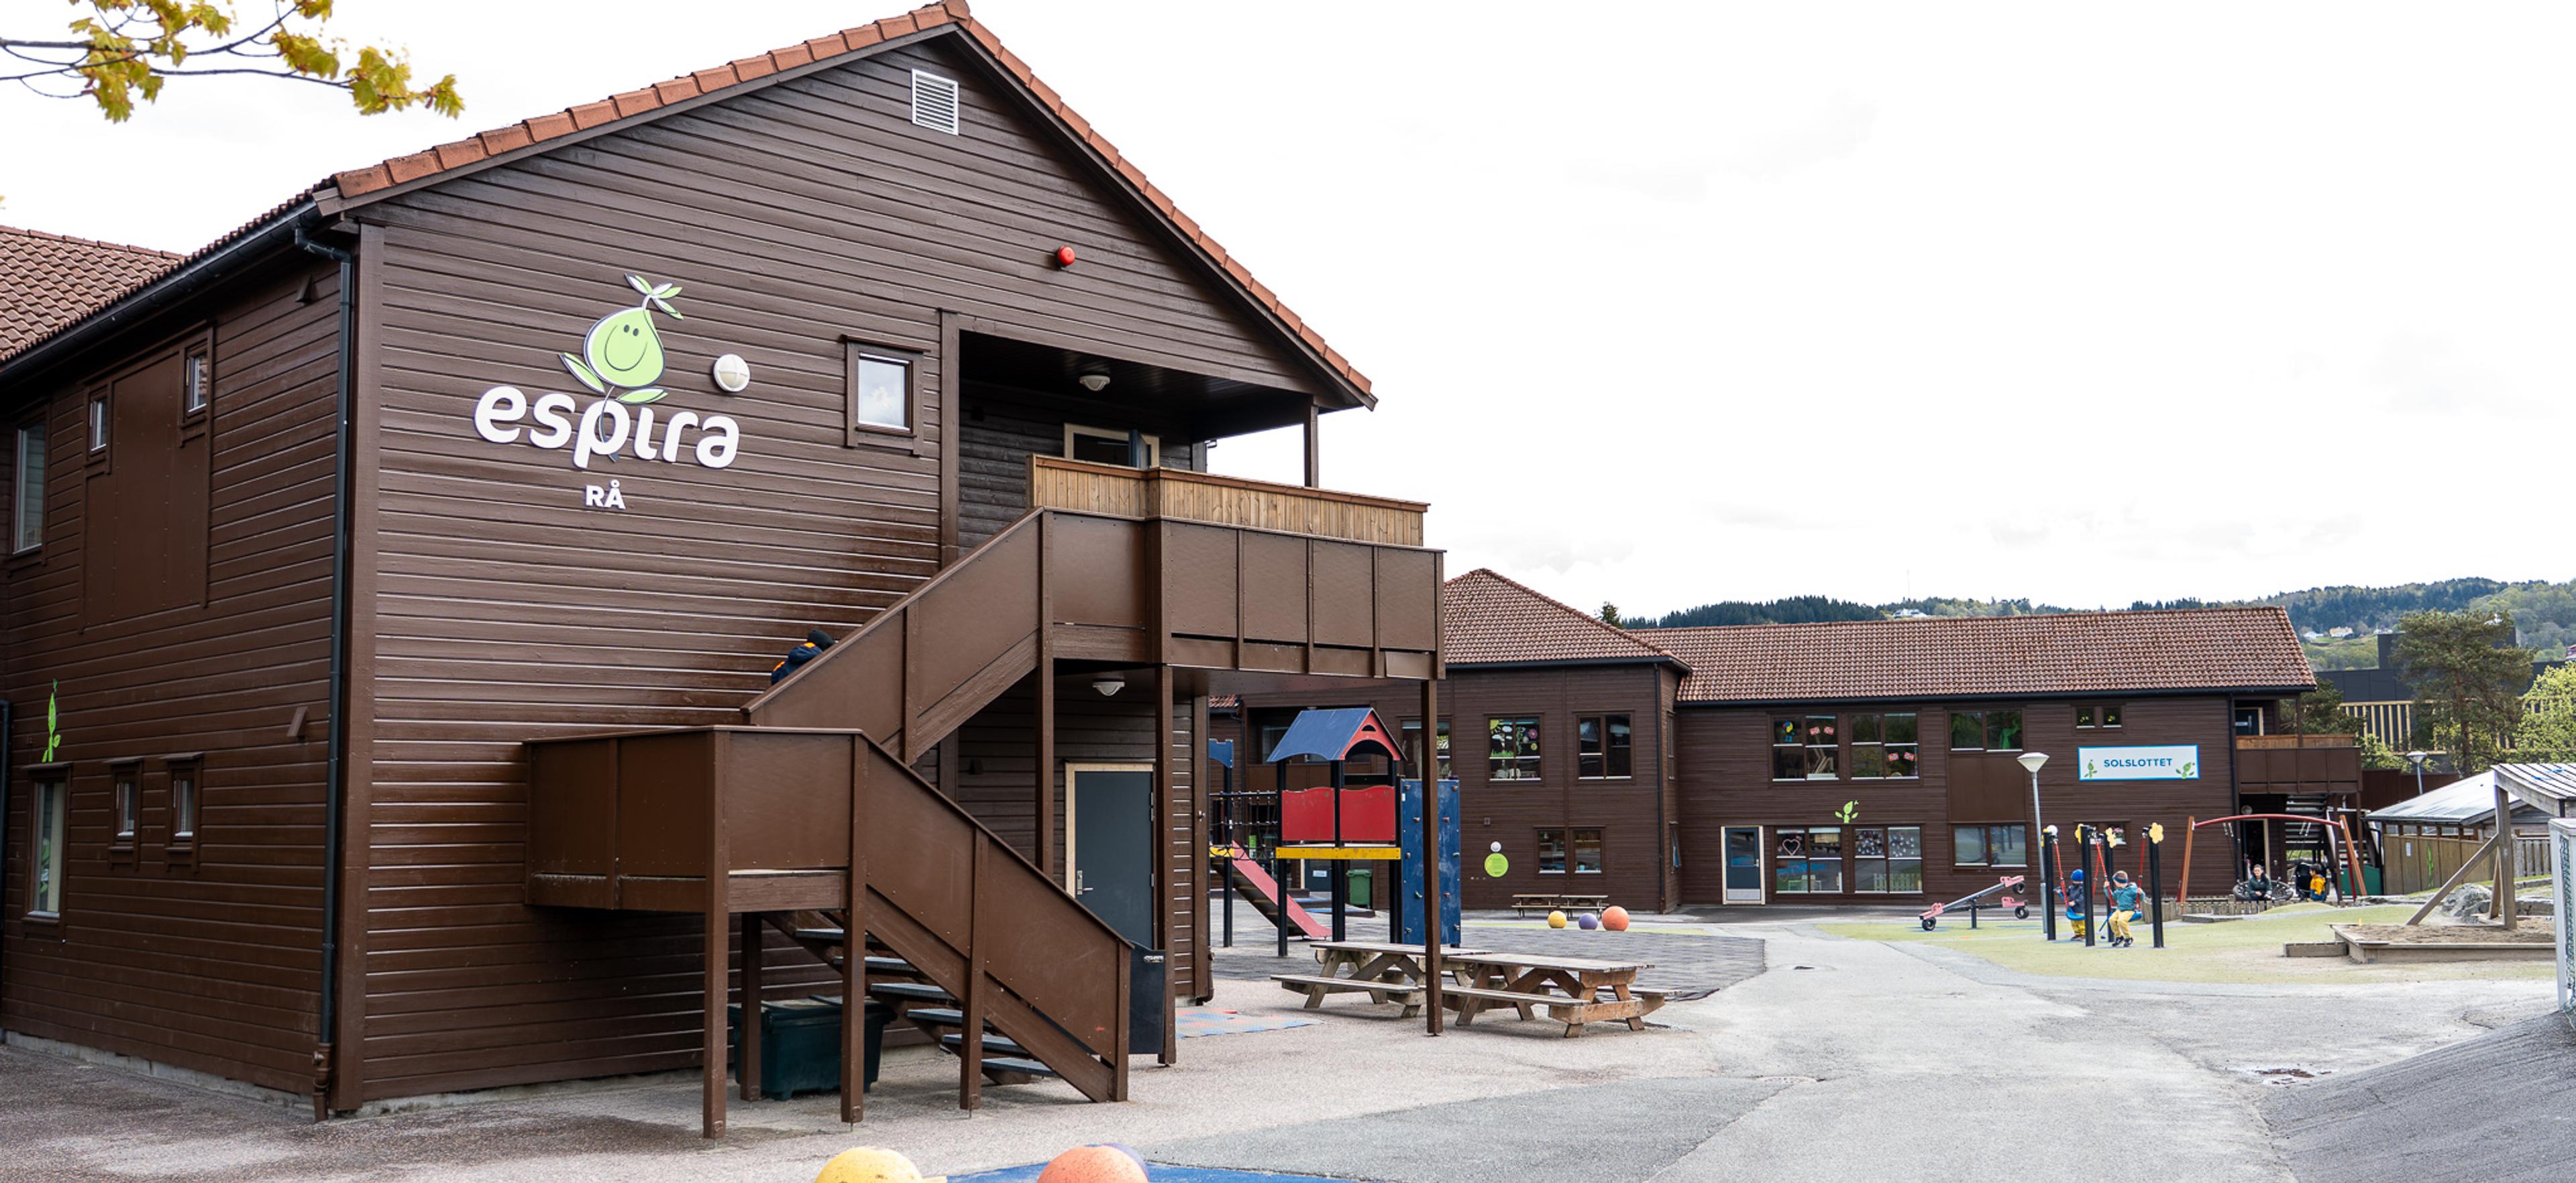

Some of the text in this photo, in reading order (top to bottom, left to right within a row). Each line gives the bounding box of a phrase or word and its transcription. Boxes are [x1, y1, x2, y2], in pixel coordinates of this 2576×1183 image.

[474, 386, 740, 469] espira
[585, 480, 626, 510] RÅ
[2103, 758, 2173, 768] SOLSLOTTET
